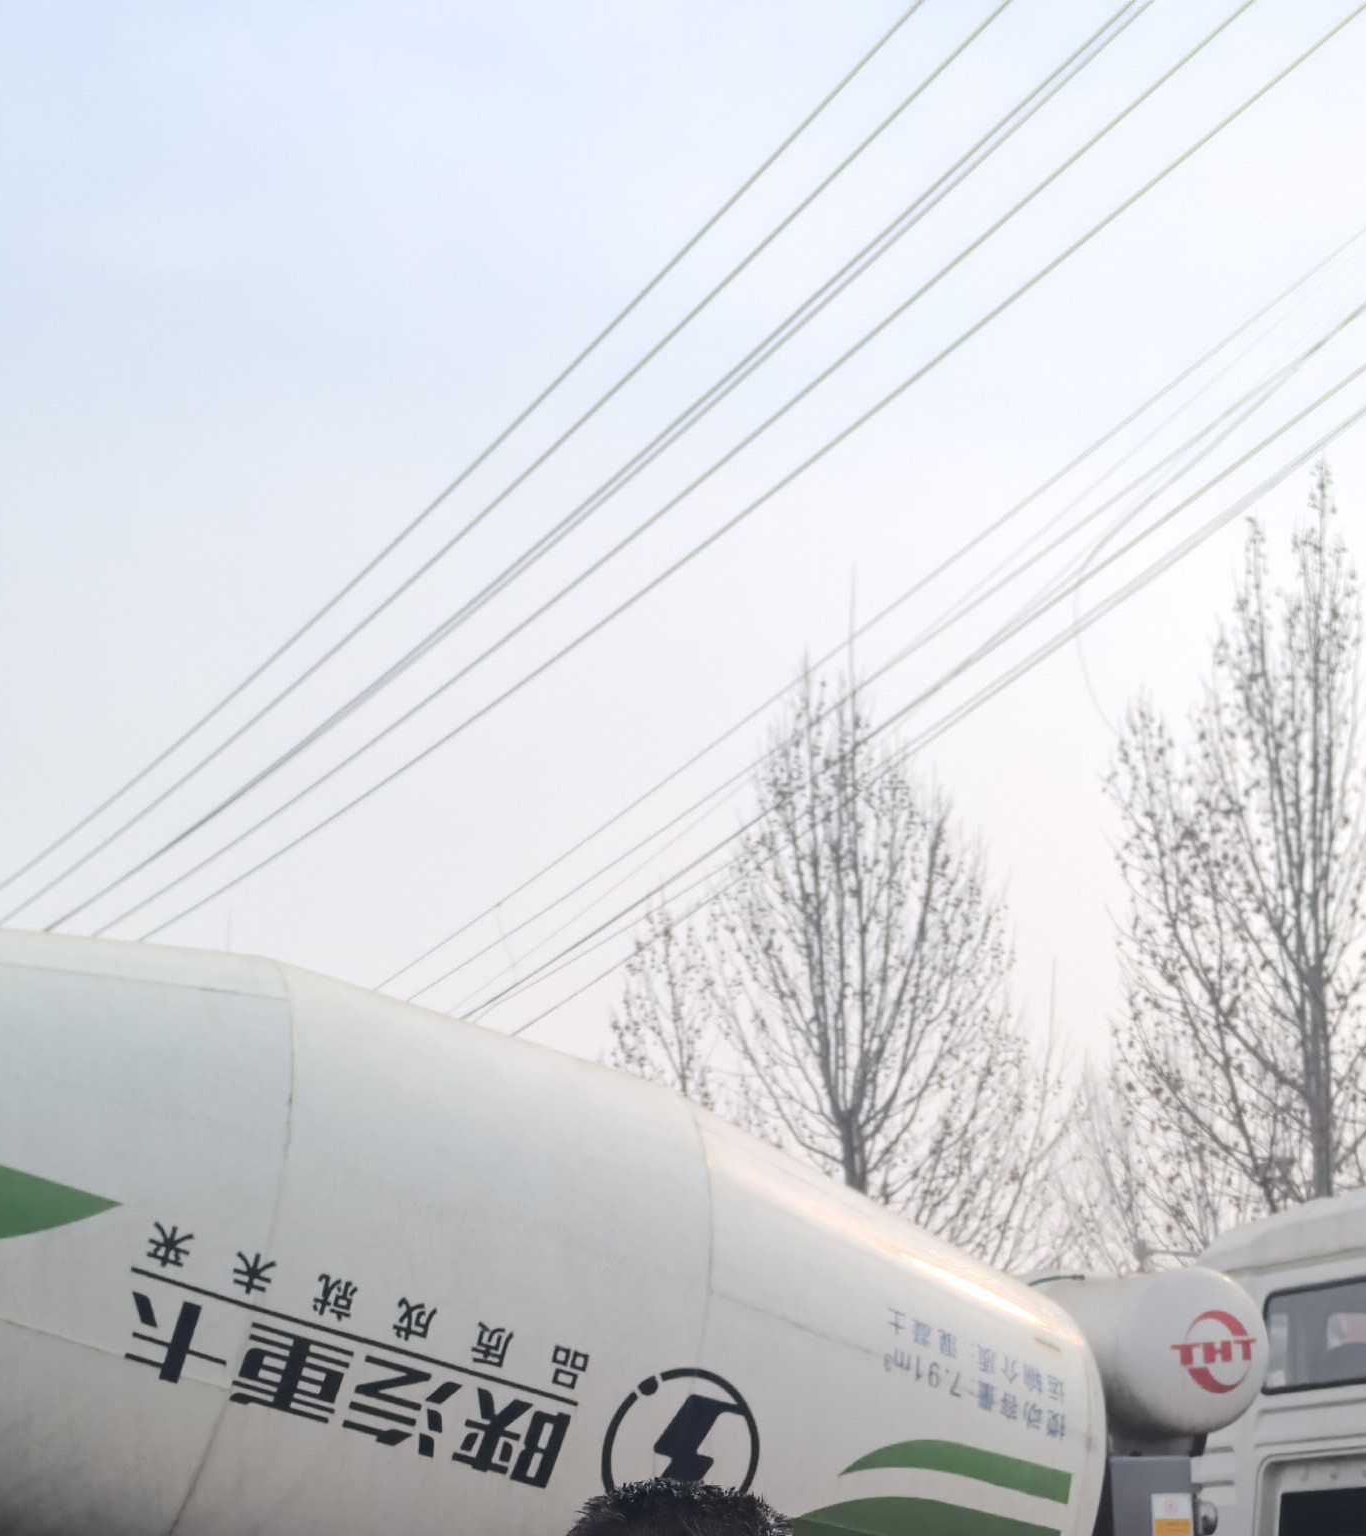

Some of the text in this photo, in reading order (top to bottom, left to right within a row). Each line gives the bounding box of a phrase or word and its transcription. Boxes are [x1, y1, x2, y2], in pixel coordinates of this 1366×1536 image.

[146, 1222, 589, 1389] 品质成就未来
[1170, 1338, 1257, 1367] THT
[124, 1290, 571, 1489] 陕汽重卡
